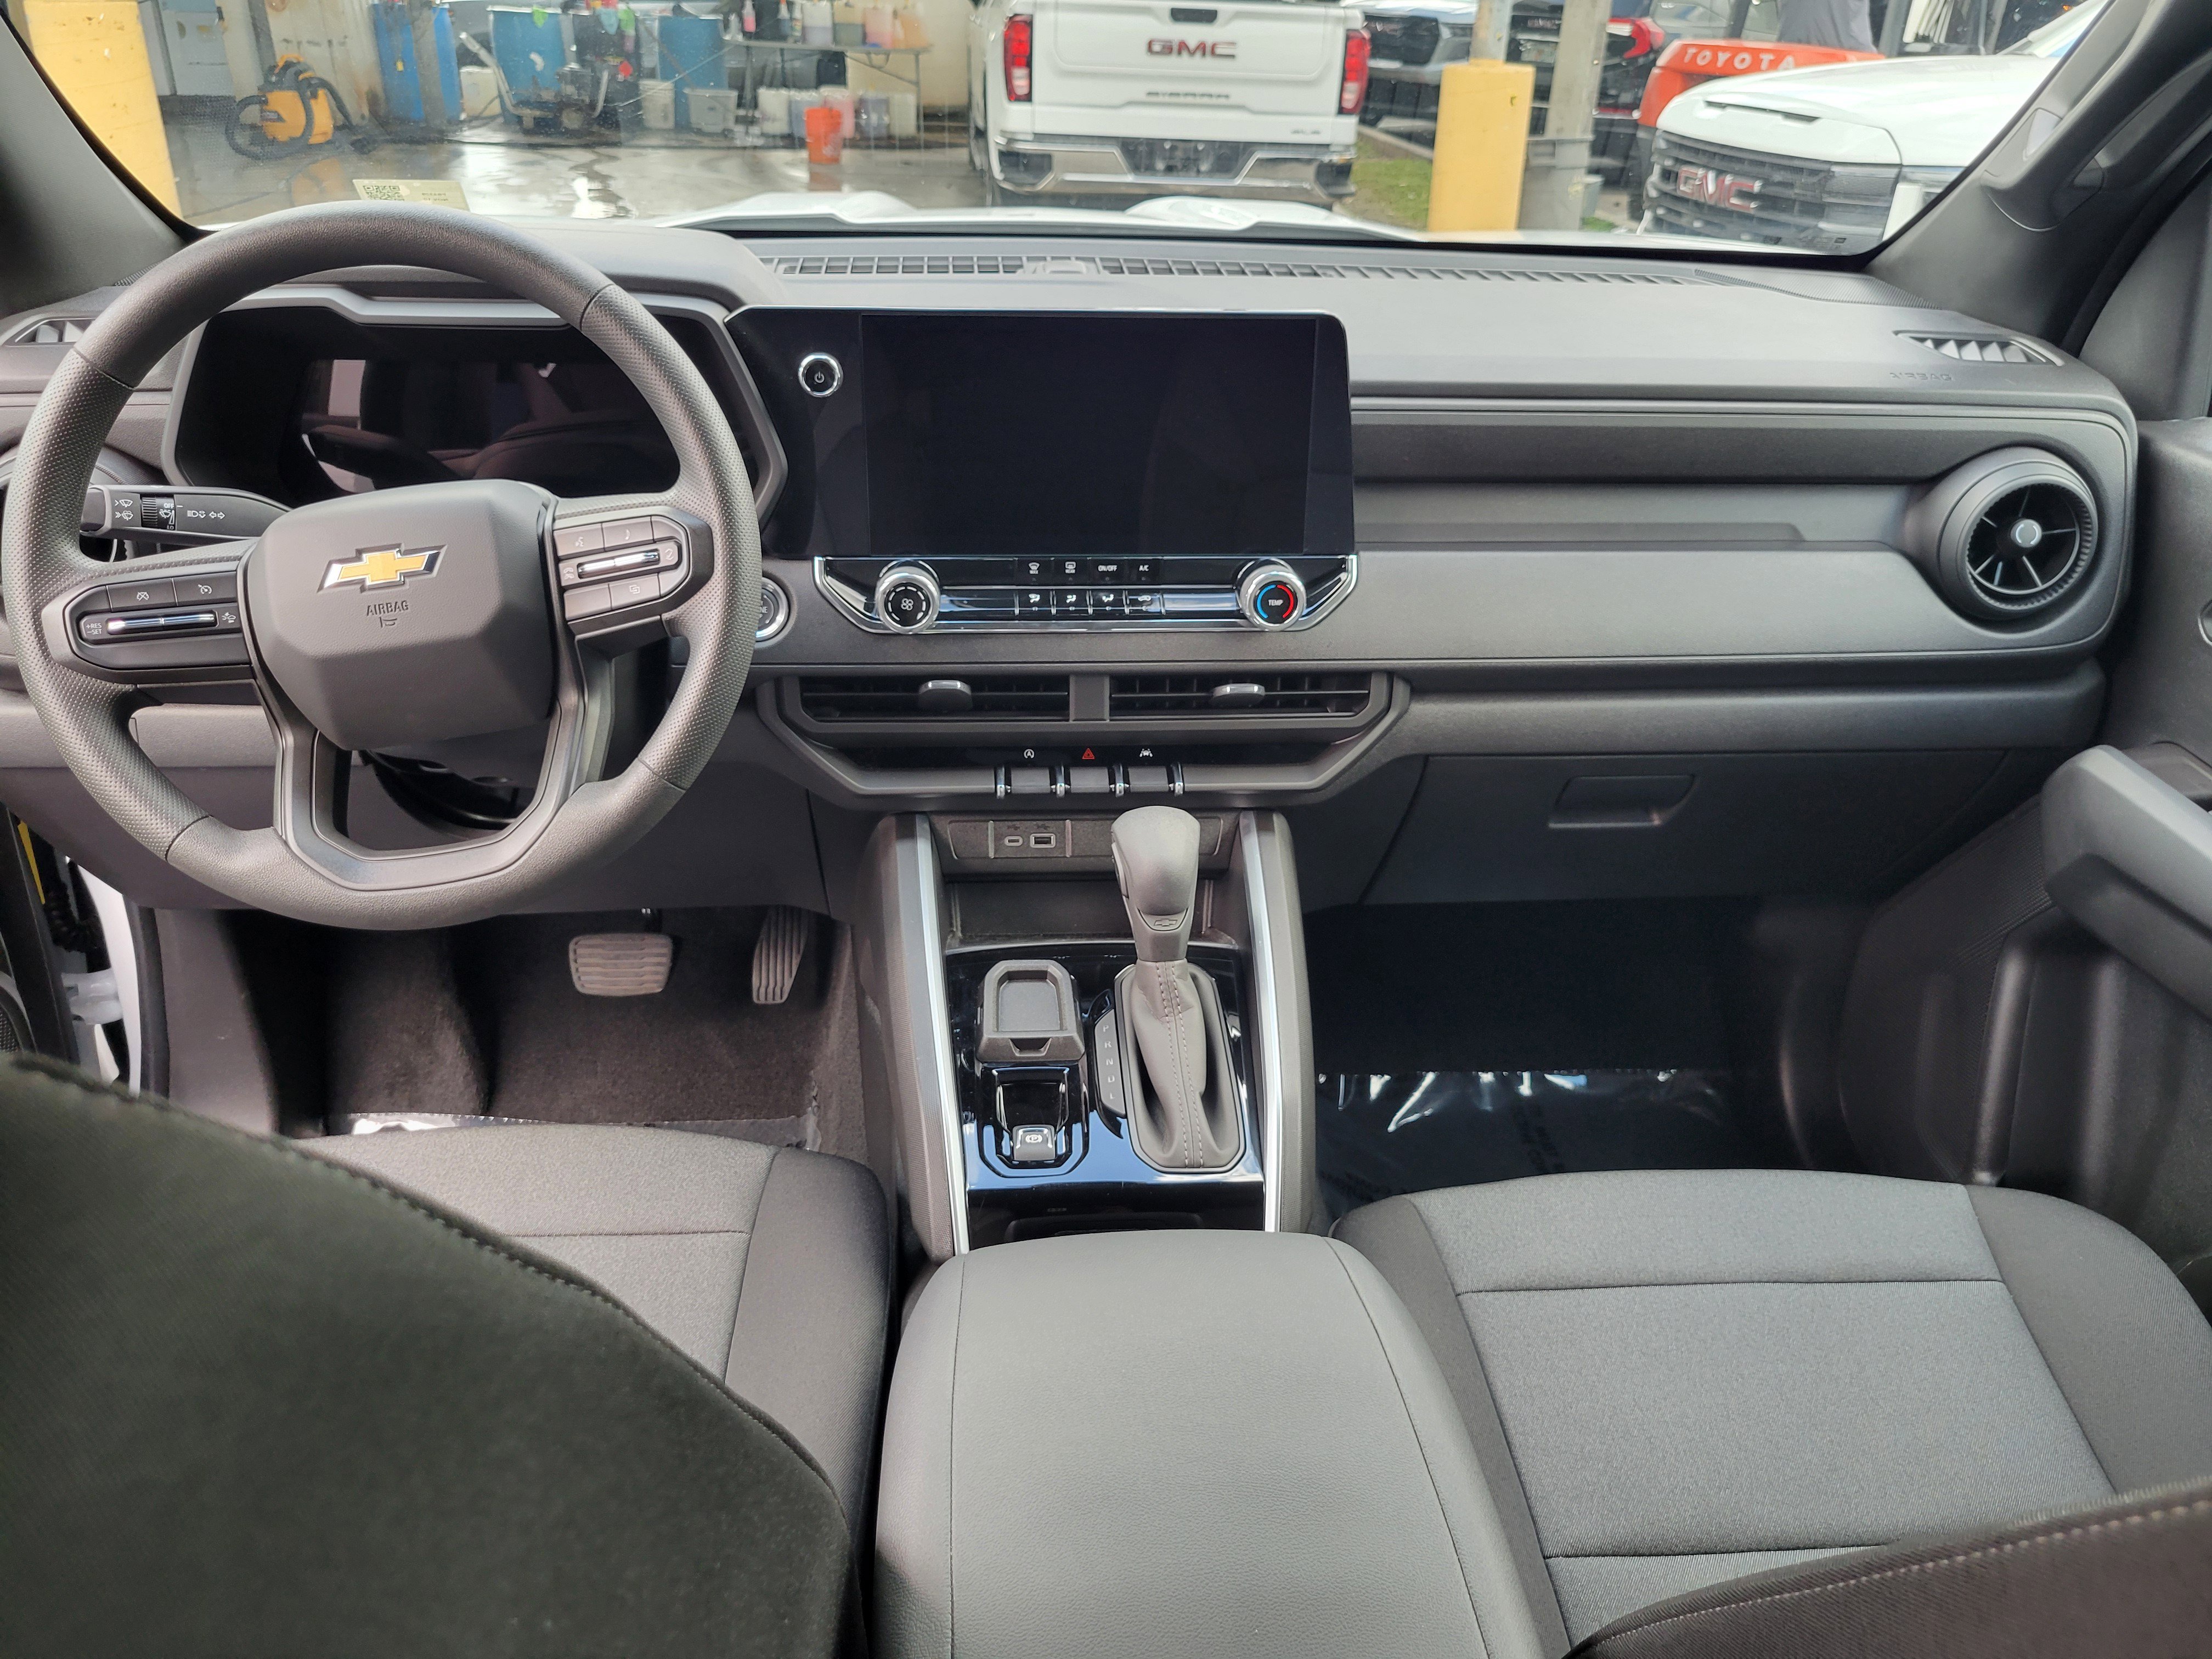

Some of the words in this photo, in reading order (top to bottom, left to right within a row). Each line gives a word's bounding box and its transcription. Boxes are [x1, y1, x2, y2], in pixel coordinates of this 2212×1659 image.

[1147, 40, 1237, 59] GMC
[1683, 47, 1795, 71] TOYOTA
[1677, 165, 1763, 213] GMC
[366, 600, 409, 617] AIRBAG
[1104, 1040, 1112, 1048] R
